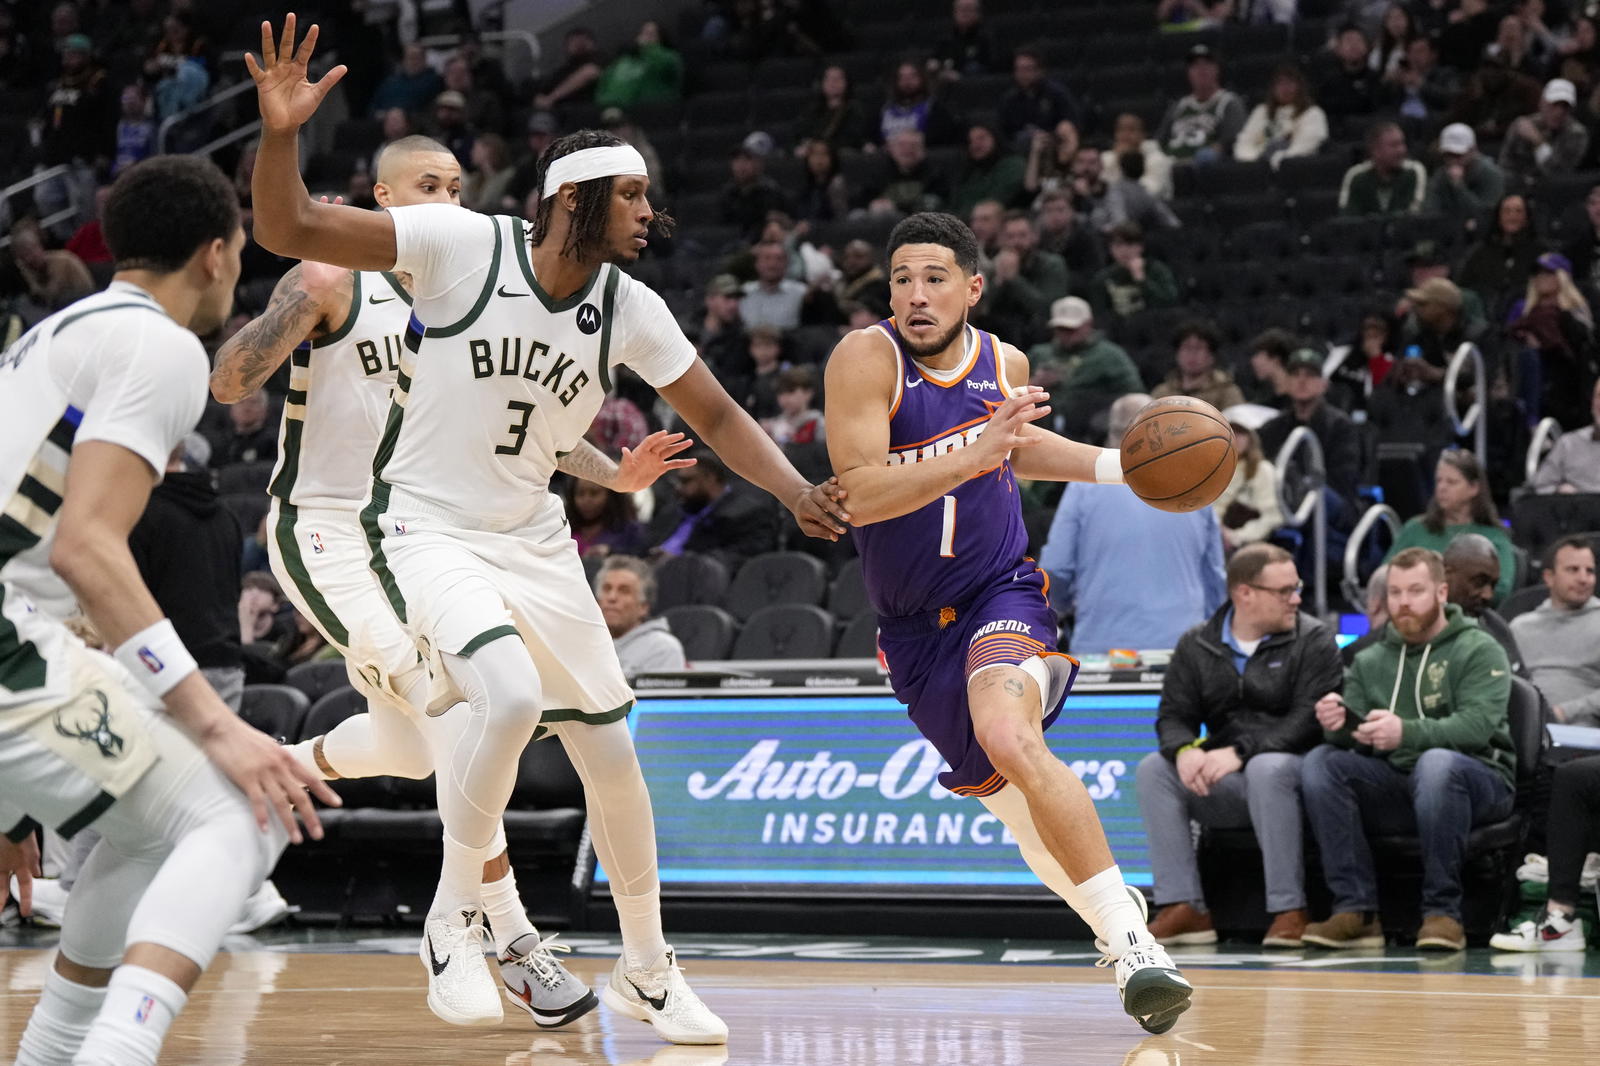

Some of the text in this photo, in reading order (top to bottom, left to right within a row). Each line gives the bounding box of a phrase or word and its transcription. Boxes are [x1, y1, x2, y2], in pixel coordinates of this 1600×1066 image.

[470, 337, 590, 408] BUCKS
[967, 379, 998, 392] PayPal
[494, 400, 536, 456] 3
[940, 495, 958, 558] 1
